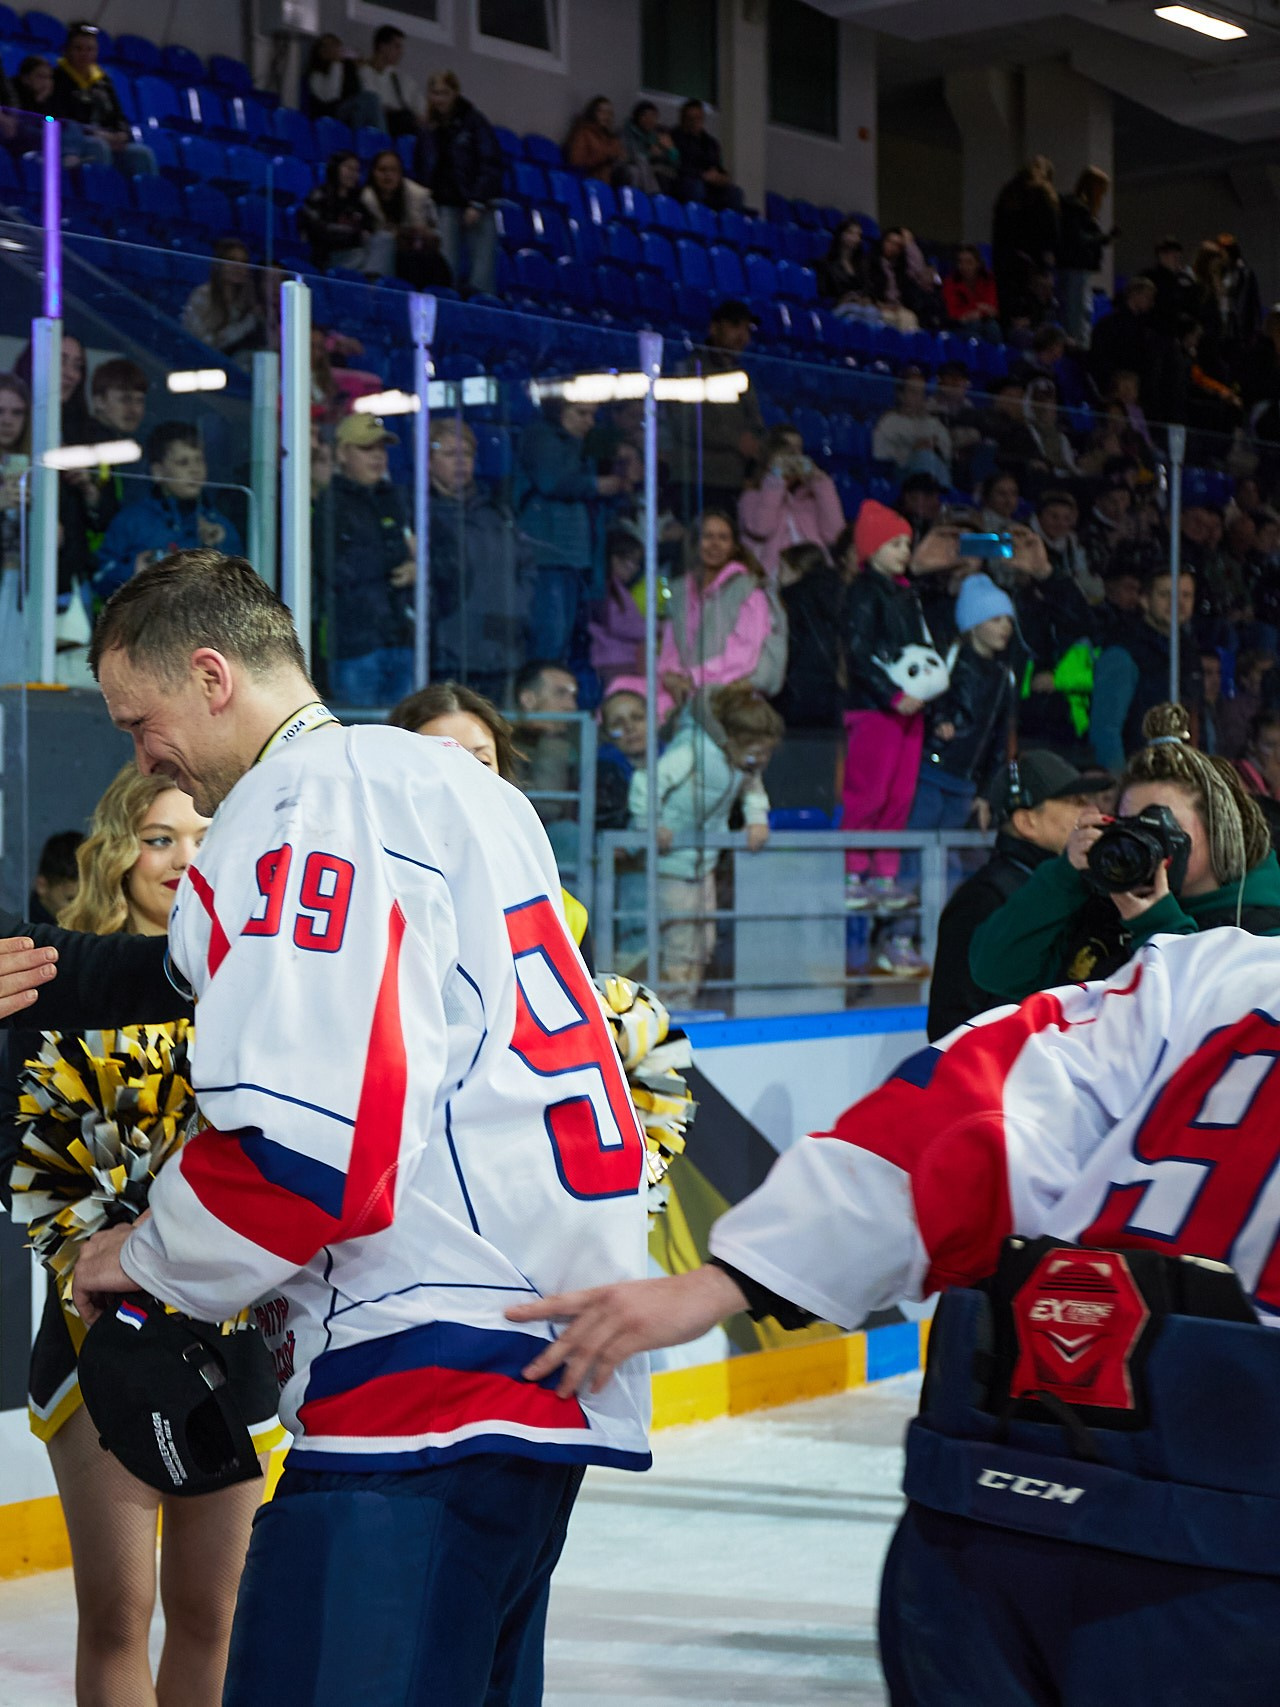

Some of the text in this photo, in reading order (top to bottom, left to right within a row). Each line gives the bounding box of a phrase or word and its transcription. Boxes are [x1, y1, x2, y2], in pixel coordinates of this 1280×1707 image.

[281, 720, 307, 742] 2024
[239, 842, 356, 954] 99
[503, 894, 647, 1201] 9
[1077, 1008, 1280, 1317] 9
[977, 1468, 1086, 1504] CCM
